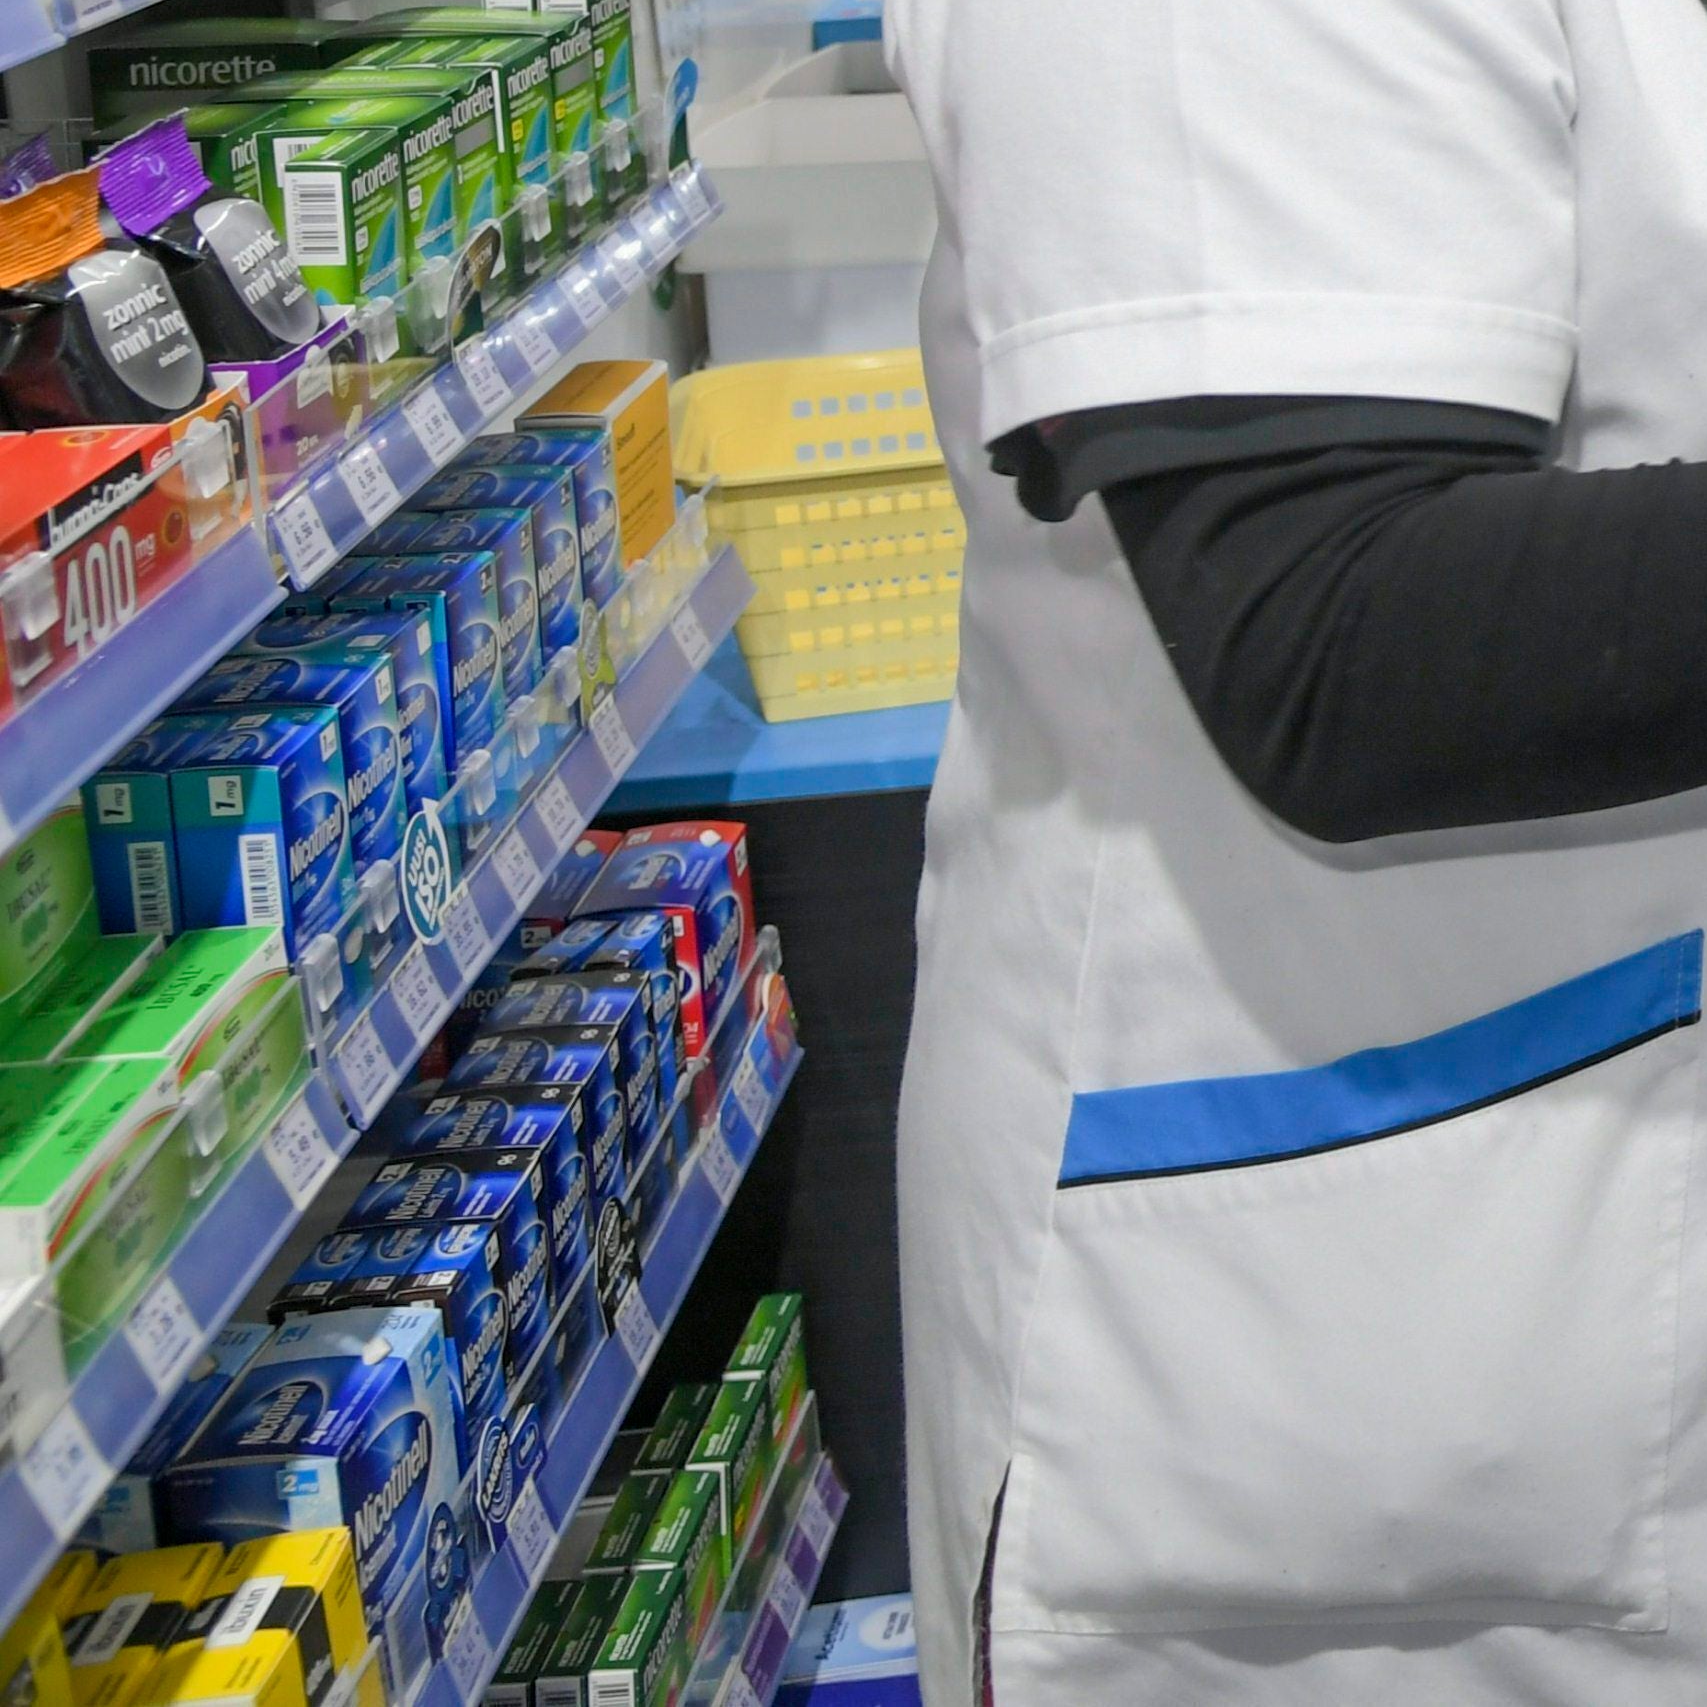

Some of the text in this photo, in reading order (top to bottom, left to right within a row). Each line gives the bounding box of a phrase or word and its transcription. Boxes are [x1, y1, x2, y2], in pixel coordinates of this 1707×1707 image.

[130, 56, 276, 86] nicorette
[551, 27, 591, 70] nicorette
[507, 56, 549, 98] nicorette
[452, 84, 493, 129] icorette
[404, 116, 454, 164] nicorette
[352, 152, 400, 203] nicorette
[233, 229, 281, 275] zonnic
[102, 282, 167, 331] zonnic
[244, 267, 277, 305] mint
[110, 325, 152, 363] mint
[64, 525, 136, 660] 400
[347, 735, 398, 807] Nicotinell
[290, 800, 343, 882] Nicotinell
[408, 828, 427, 886] UUSI
[414, 845, 440, 923] ISO
[463, 1296, 505, 1386] Nicotinell
[354, 1419, 427, 1561] Nicotinell
[219, 1587, 268, 1636] ibuxin
